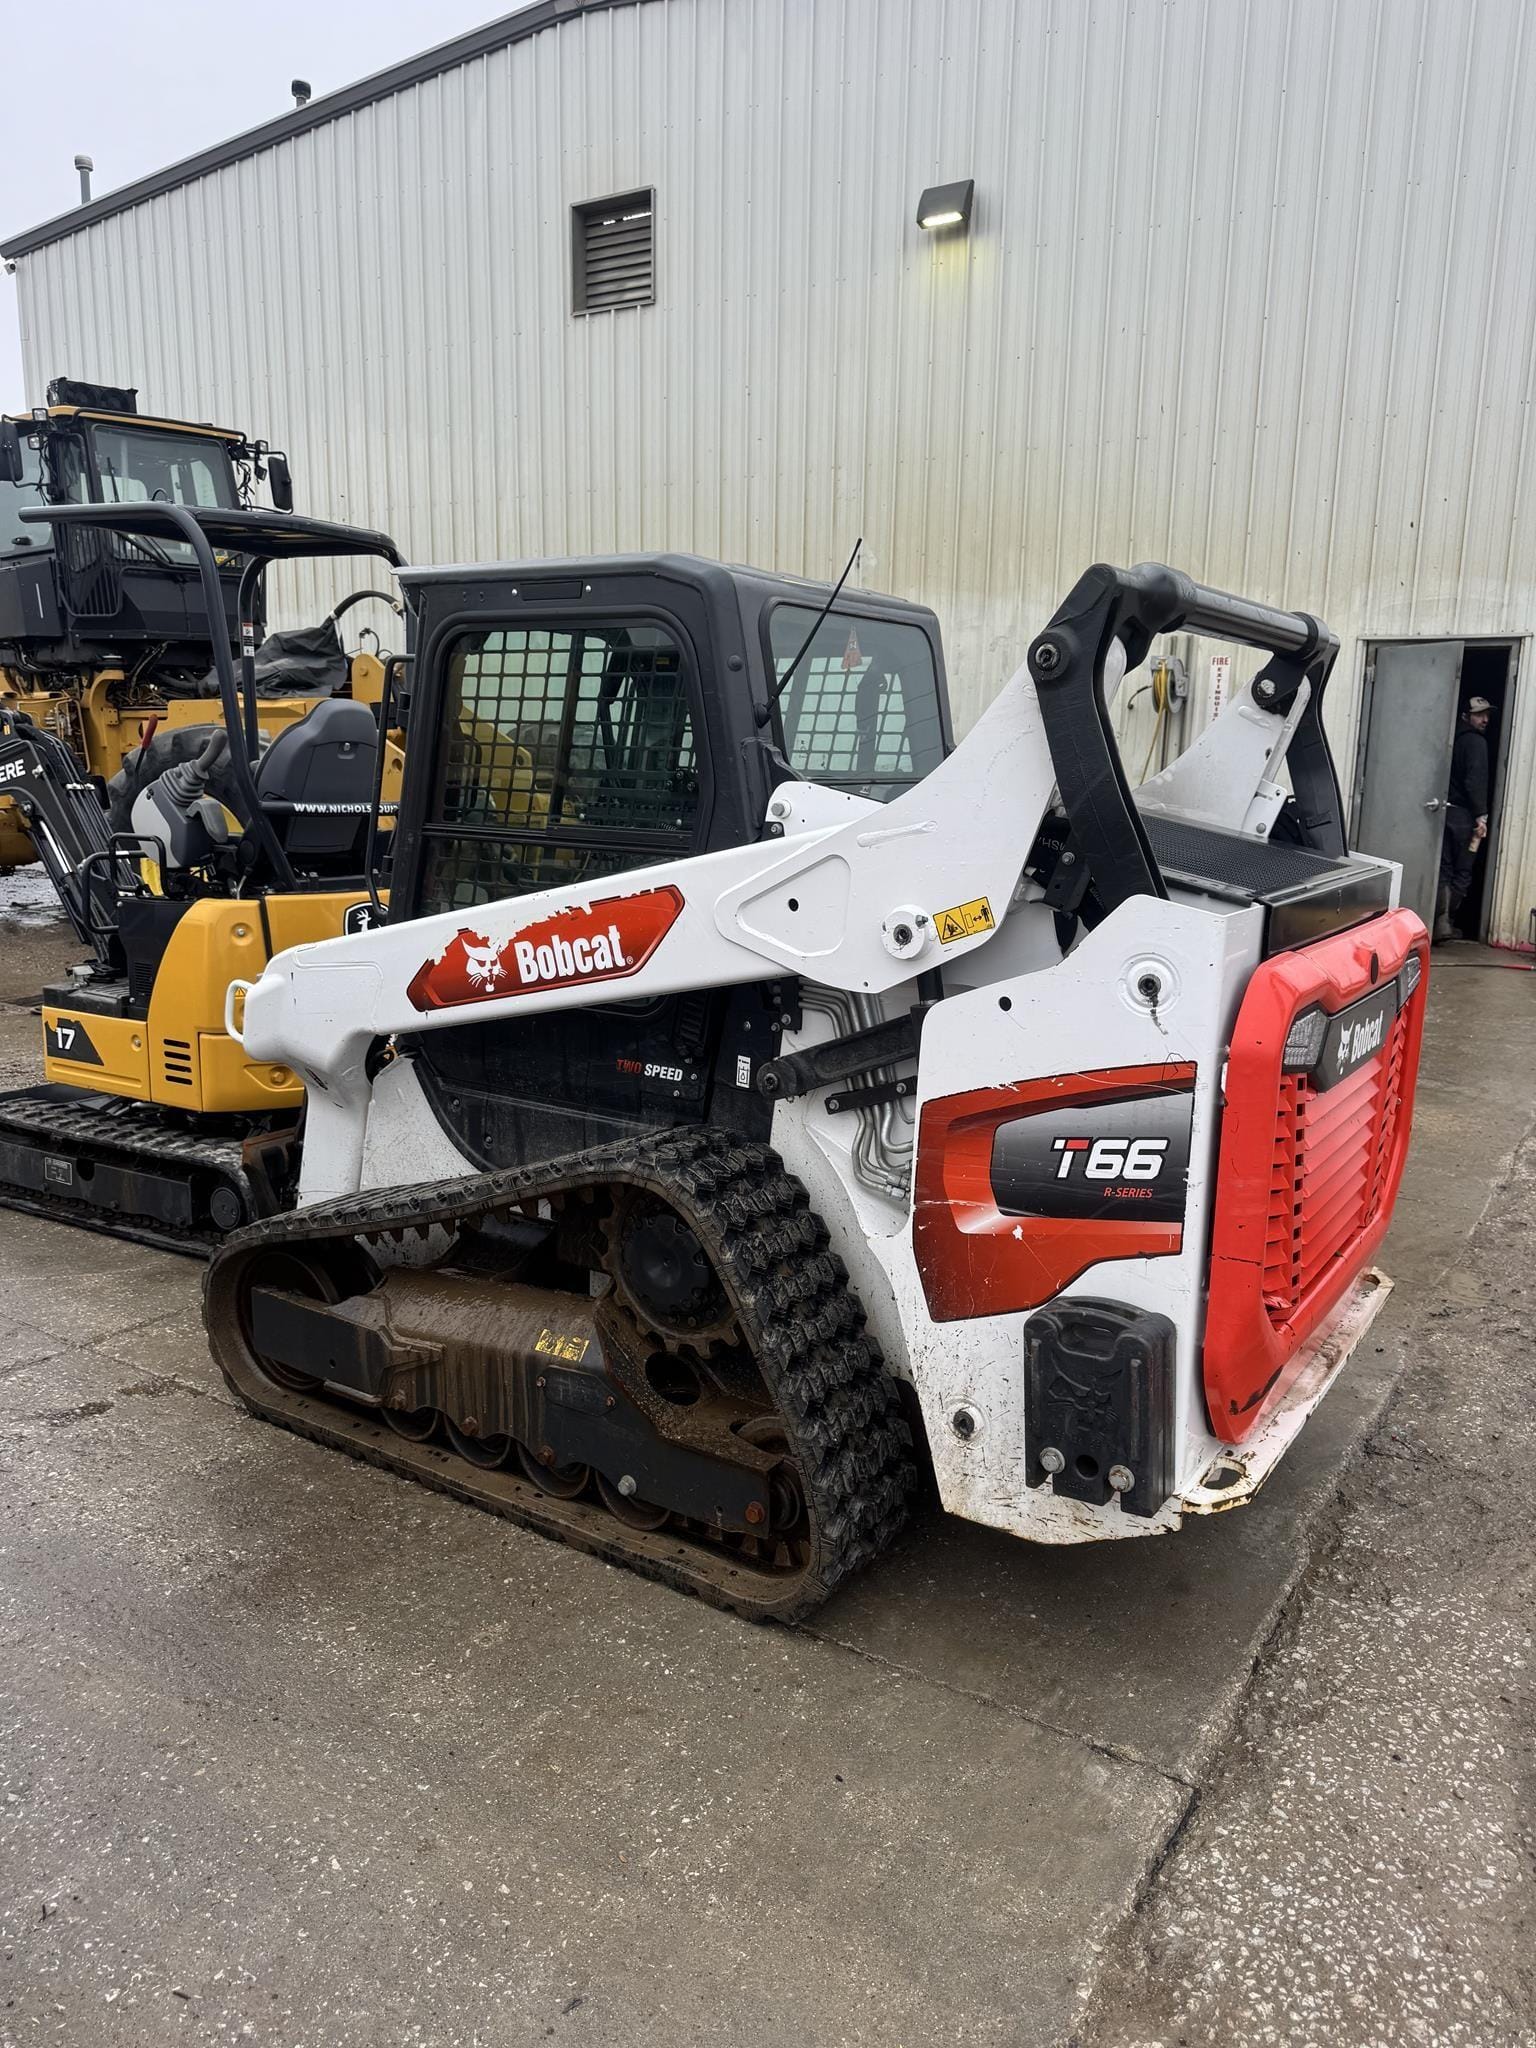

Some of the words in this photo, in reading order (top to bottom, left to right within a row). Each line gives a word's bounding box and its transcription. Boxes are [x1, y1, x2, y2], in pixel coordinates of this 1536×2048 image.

[1212, 657, 1229, 665] FIRE
[1212, 667, 1222, 721] EXTINGUIS
[514, 925, 626, 983] Bobcat
[55, 1026, 75, 1050] 17
[1350, 1010, 1383, 1063] Bobcat
[616, 1059, 642, 1074] TWO
[644, 1064, 683, 1081] SPEED
[1052, 1138, 1169, 1179] T66
[1103, 1187, 1153, 1198] R-SERIES
